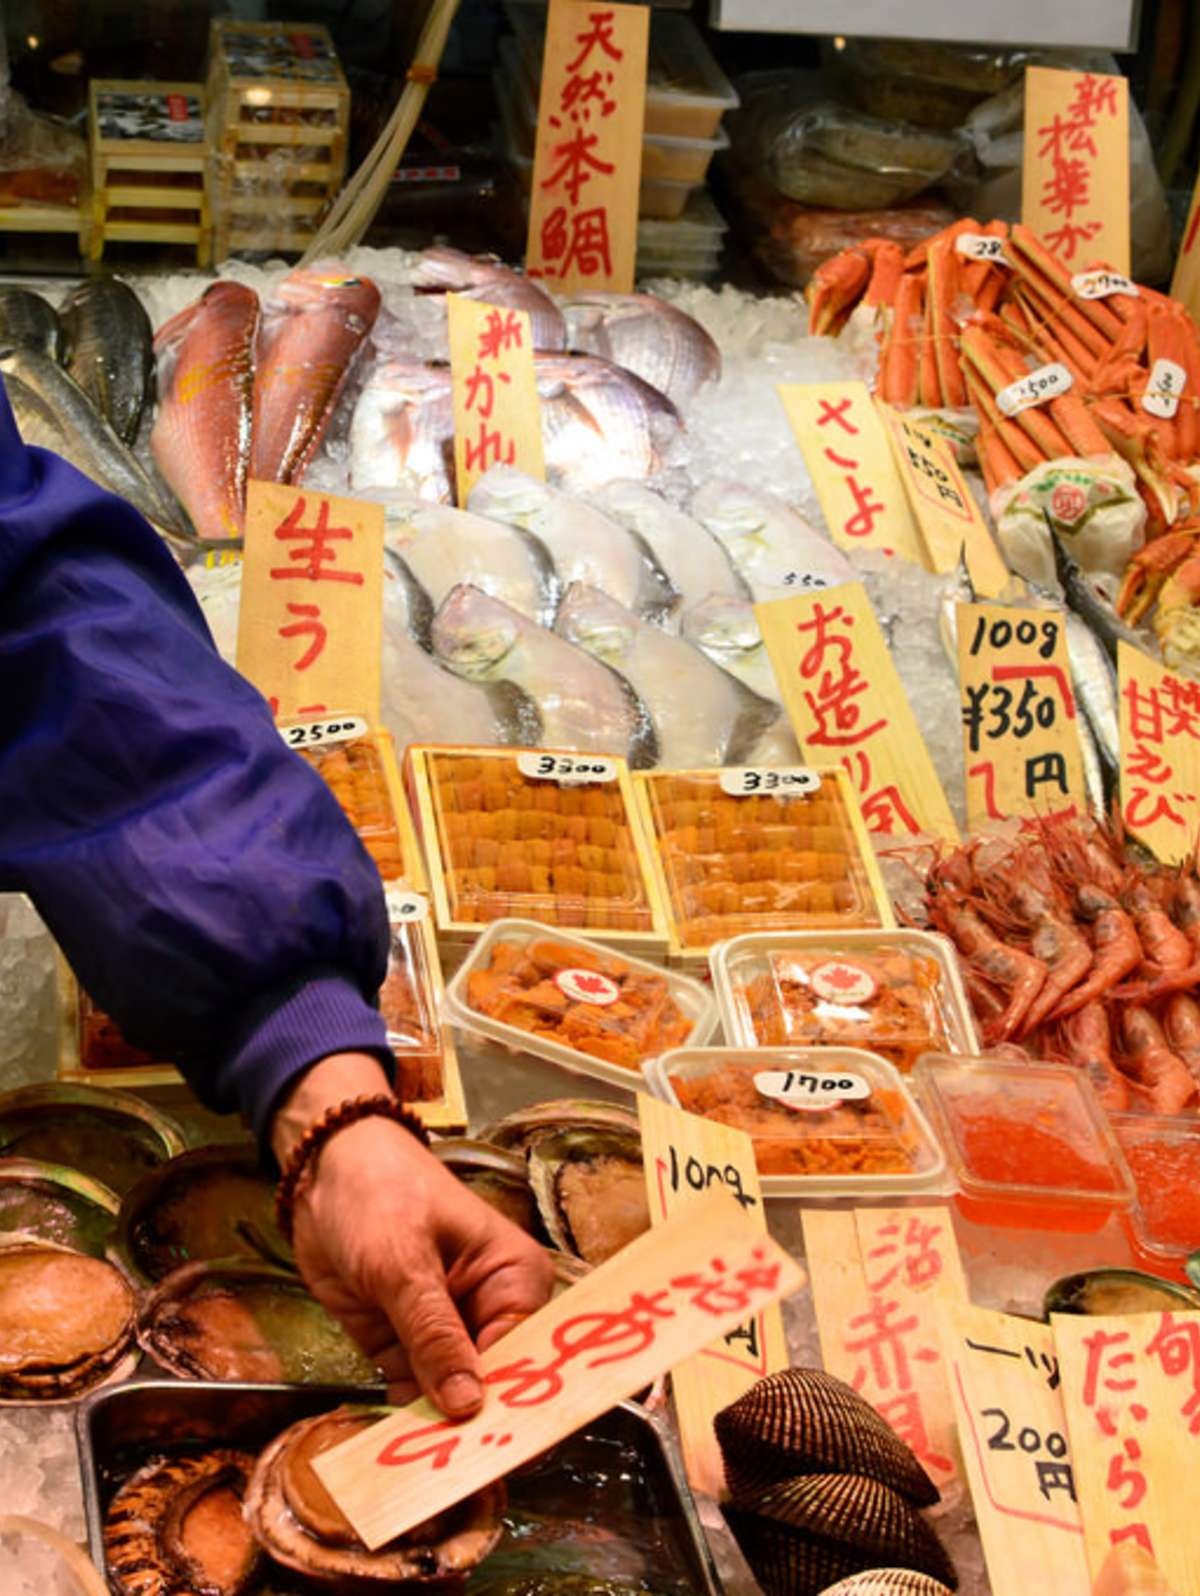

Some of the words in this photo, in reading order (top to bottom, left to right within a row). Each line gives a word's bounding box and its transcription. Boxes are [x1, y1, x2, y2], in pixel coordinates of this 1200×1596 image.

[528, 11, 624, 279] 天然本鯛
[815, 397, 894, 557] さよ
[268, 496, 364, 715] 生う
[969, 616, 1059, 659] 100g
[288, 722, 356, 745] 2500
[1122, 676, 1197, 830] 甘えび
[536, 755, 607, 775] 3300
[742, 771, 810, 791] 3300
[1025, 752, 1070, 798] 円
[782, 1071, 854, 1094] 1700
[1145, 1311, 1200, 1436] 旬
[980, 1408, 1068, 1459] 200
[1034, 1461, 1079, 1504] 円
